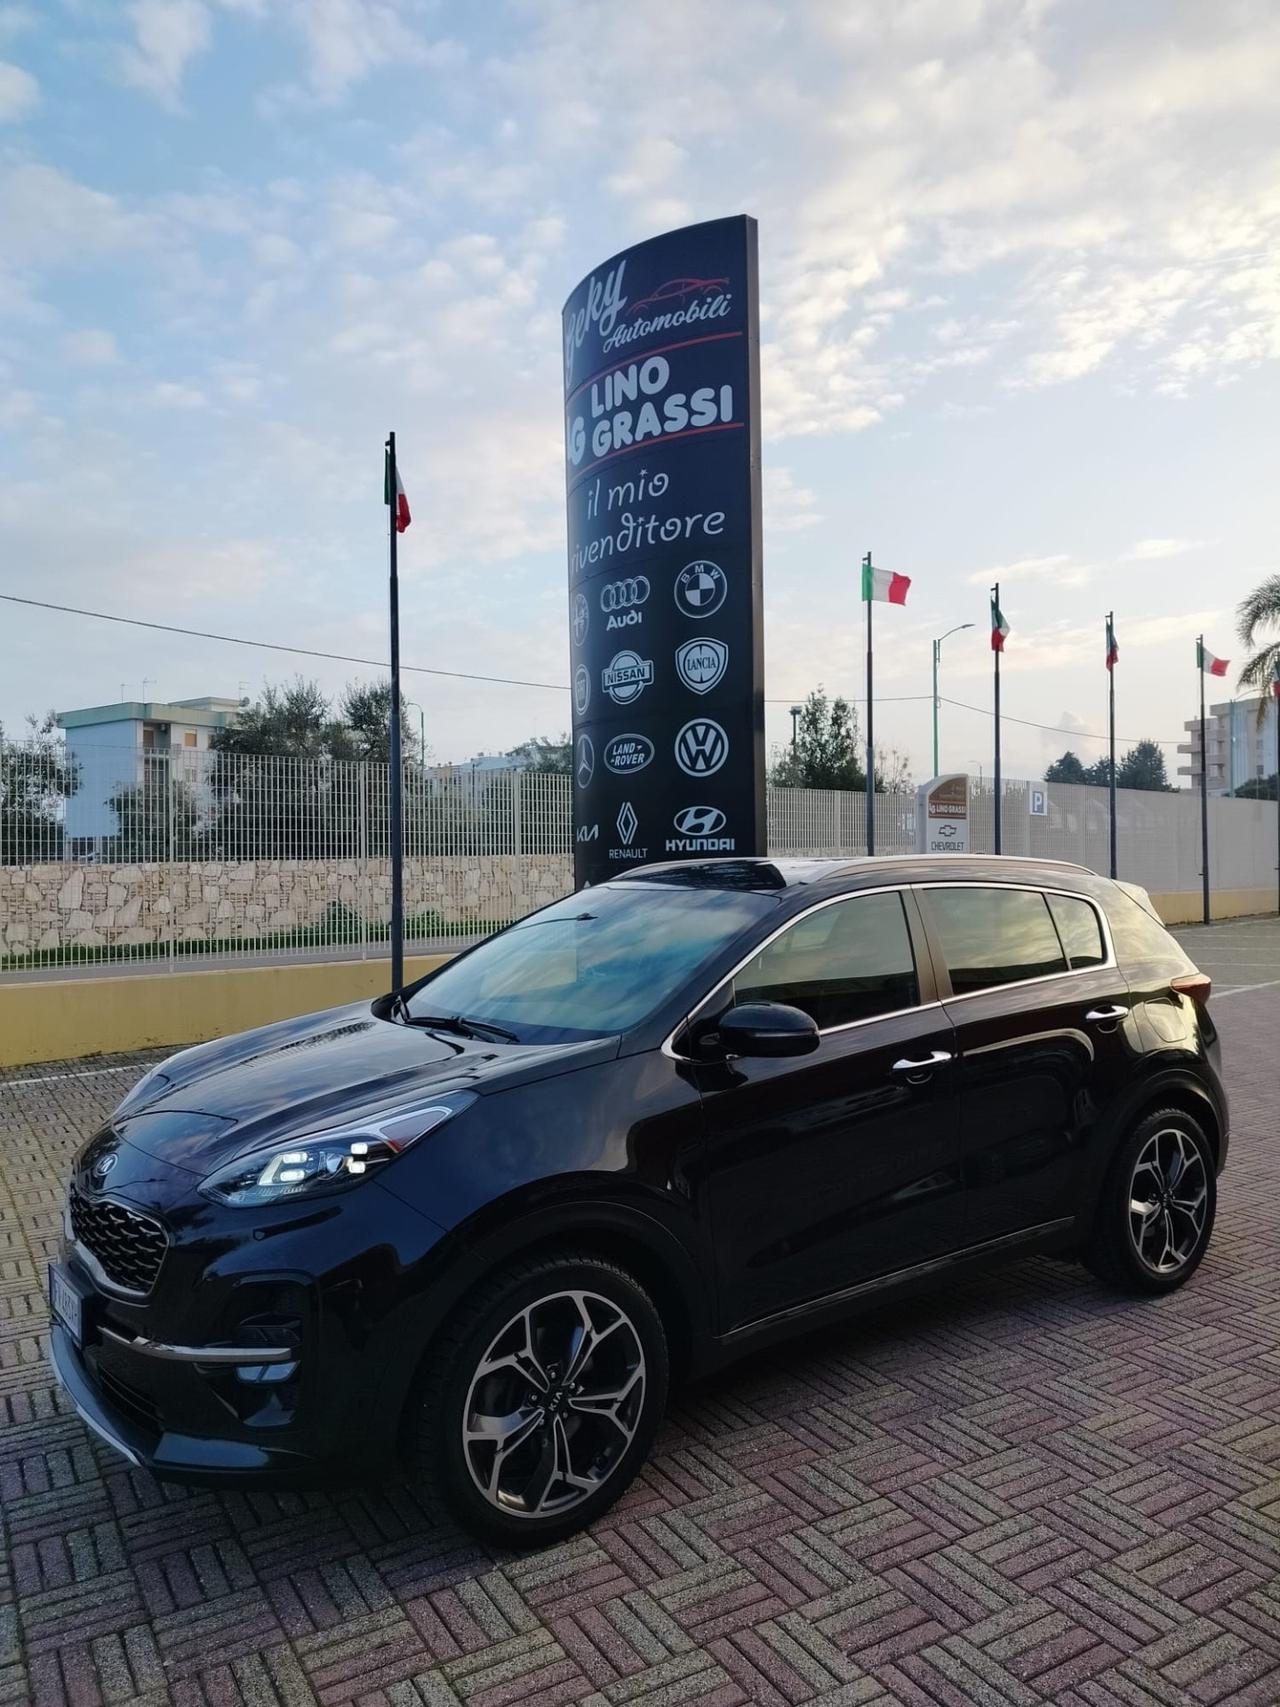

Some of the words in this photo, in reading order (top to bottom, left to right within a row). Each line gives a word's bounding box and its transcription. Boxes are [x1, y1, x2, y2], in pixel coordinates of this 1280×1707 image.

[603, 294, 732, 353] Automobili
[591, 356, 670, 419] LINO
[592, 385, 733, 457] GRASSI
[587, 479, 600, 520] il
[607, 469, 669, 511] mio
[680, 564, 721, 584] BMW
[606, 610, 642, 631] Audi
[687, 656, 717, 671] LANCIA
[607, 667, 646, 684] NISSAN
[613, 743, 636, 756] LAND
[1034, 792, 1043, 812] P
[609, 848, 648, 860] RENAULT
[665, 838, 735, 851] HYUNDAI
[931, 841, 964, 851] CHEVROLET
